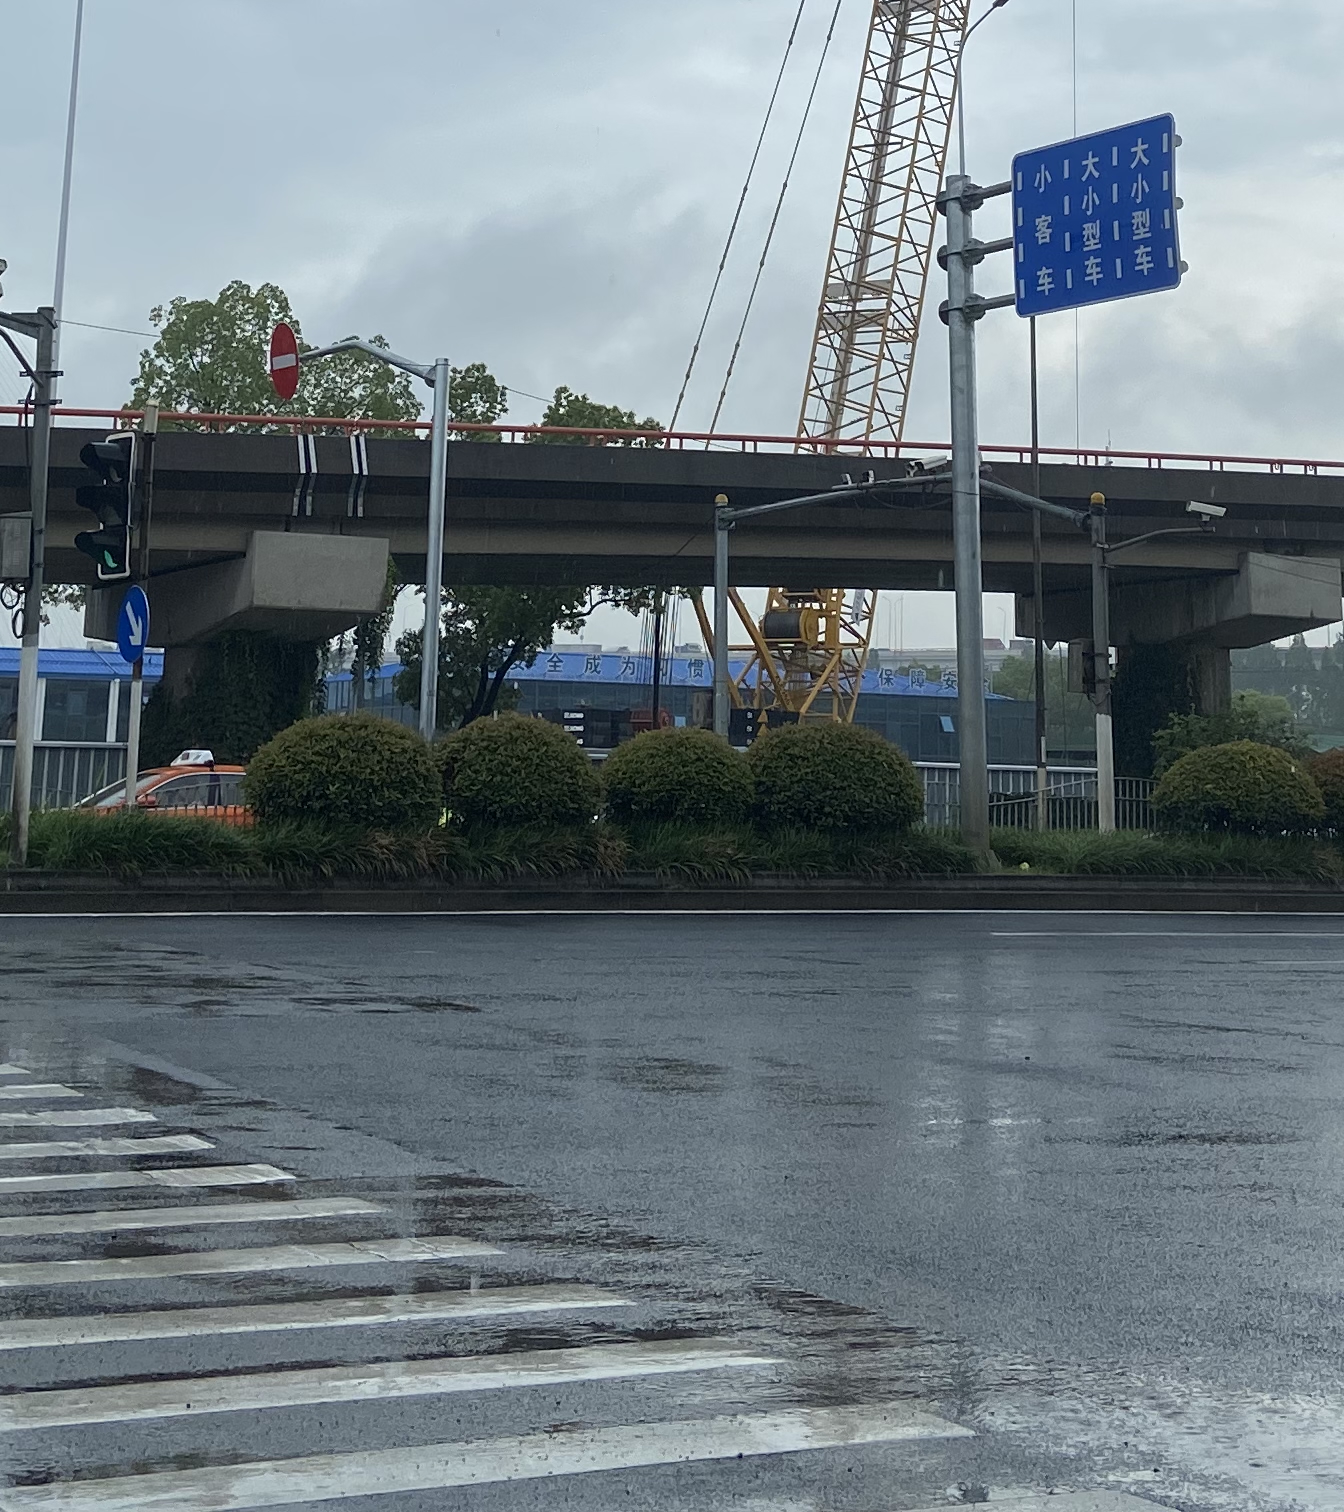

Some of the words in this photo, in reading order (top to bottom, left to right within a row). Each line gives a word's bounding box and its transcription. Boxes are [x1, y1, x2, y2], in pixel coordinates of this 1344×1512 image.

[1034, 164, 1055, 295] 小客车
[1081, 151, 1103, 286] 大小型车
[1130, 137, 1154, 275] 大小型车
